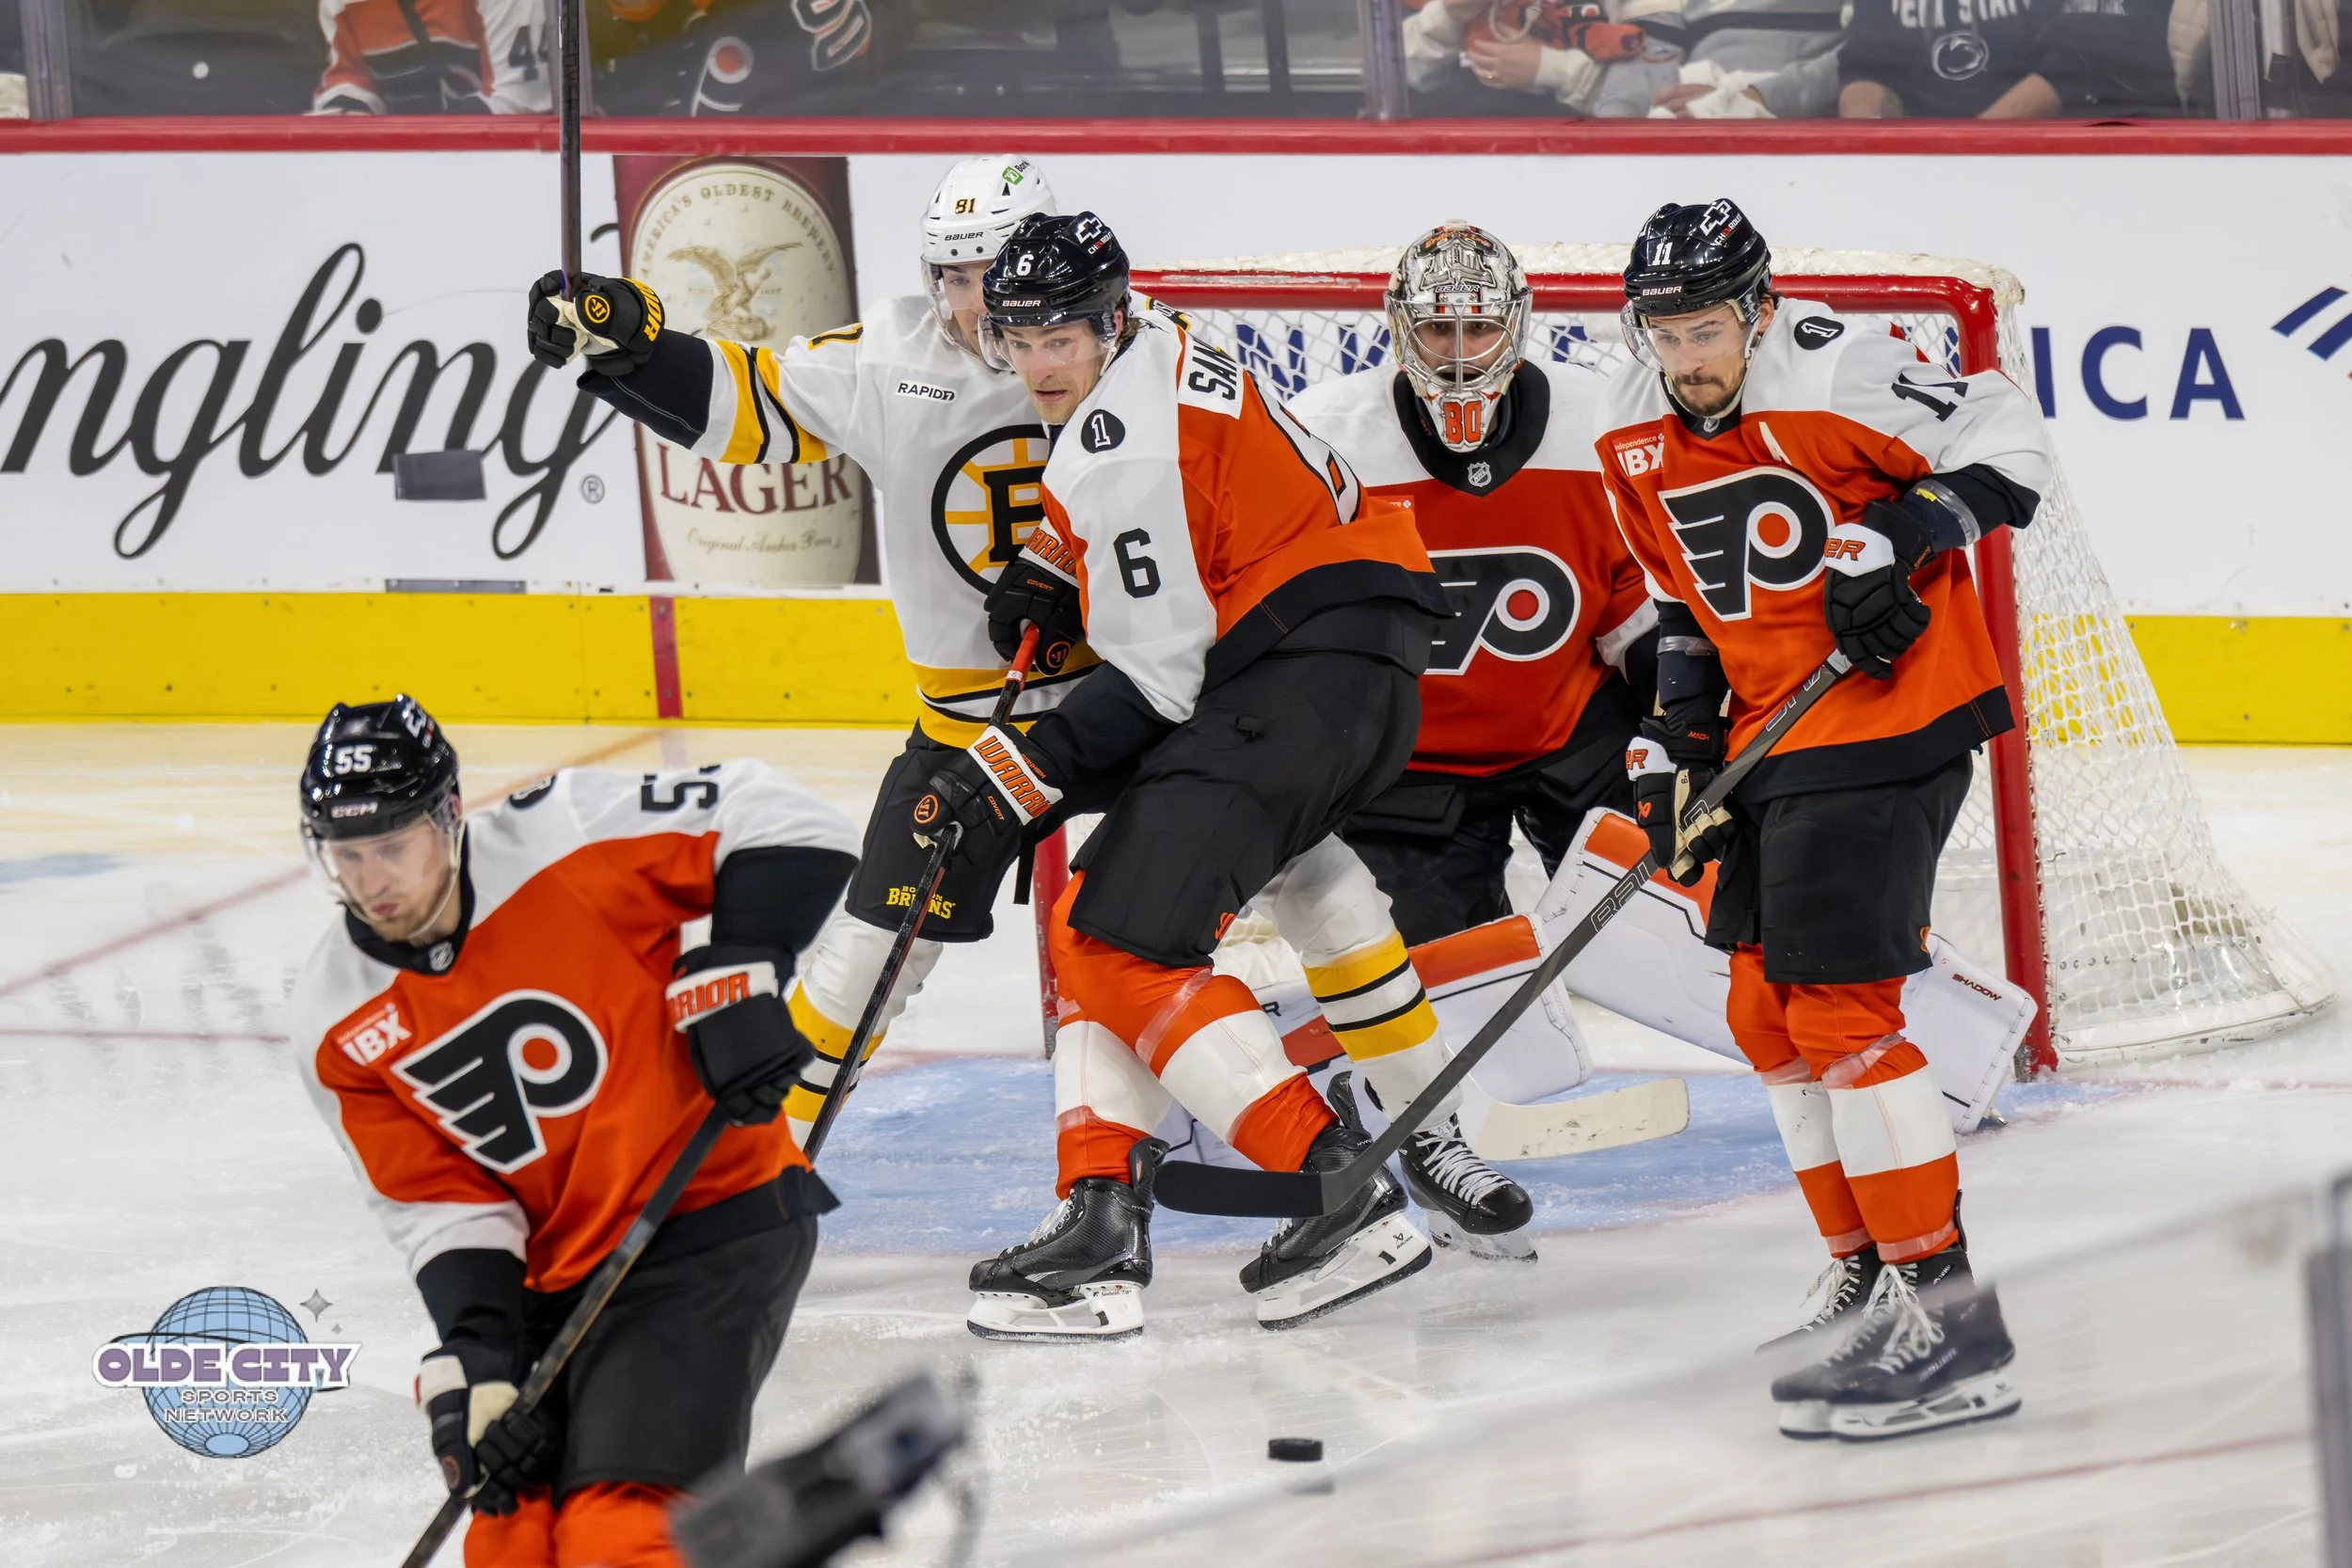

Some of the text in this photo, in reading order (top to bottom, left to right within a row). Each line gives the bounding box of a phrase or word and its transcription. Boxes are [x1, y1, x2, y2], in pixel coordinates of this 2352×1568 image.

[700, 183, 774, 202] OLDEST
[955, 198, 977, 214] 81
[945, 231, 983, 242] BAUER
[1017, 254, 1034, 277] 6
[1651, 242, 1673, 266] 11
[1002, 298, 1041, 309] BAUER
[1642, 285, 1682, 296] BAUER
[1090, 413, 1112, 449] 1
[1443, 400, 1483, 445] 80
[1616, 442, 1664, 478] IBX
[657, 442, 853, 515] LAGER
[1113, 528, 1162, 599] 6
[334, 744, 373, 775] 55
[886, 887, 952, 920] BRNS
[1952, 973, 2002, 1001] SHADOW
[342, 1011, 413, 1067] IBX
